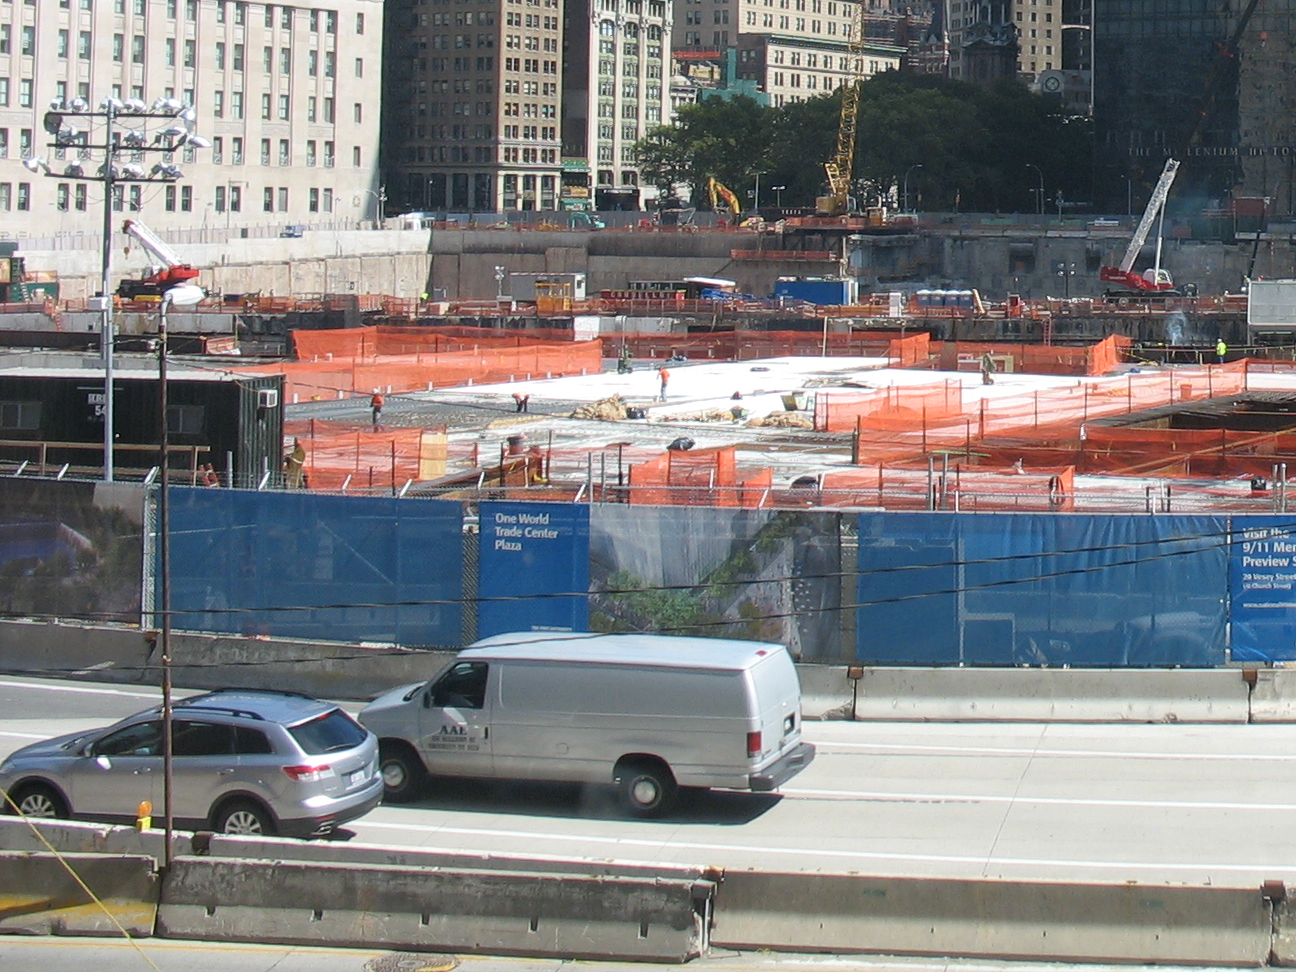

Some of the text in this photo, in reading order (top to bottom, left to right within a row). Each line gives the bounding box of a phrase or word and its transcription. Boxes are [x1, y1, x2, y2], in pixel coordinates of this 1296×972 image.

[1128, 147, 1151, 156] THE
[1163, 147, 1238, 156] MILENIUM
[495, 512, 549, 525] One World
[495, 526, 559, 539] Trade Center
[1243, 526, 1290, 539] Visit the
[494, 539, 522, 551] Plaza
[1243, 541, 1269, 554] 9/11
[1243, 555, 1290, 567] Preview
